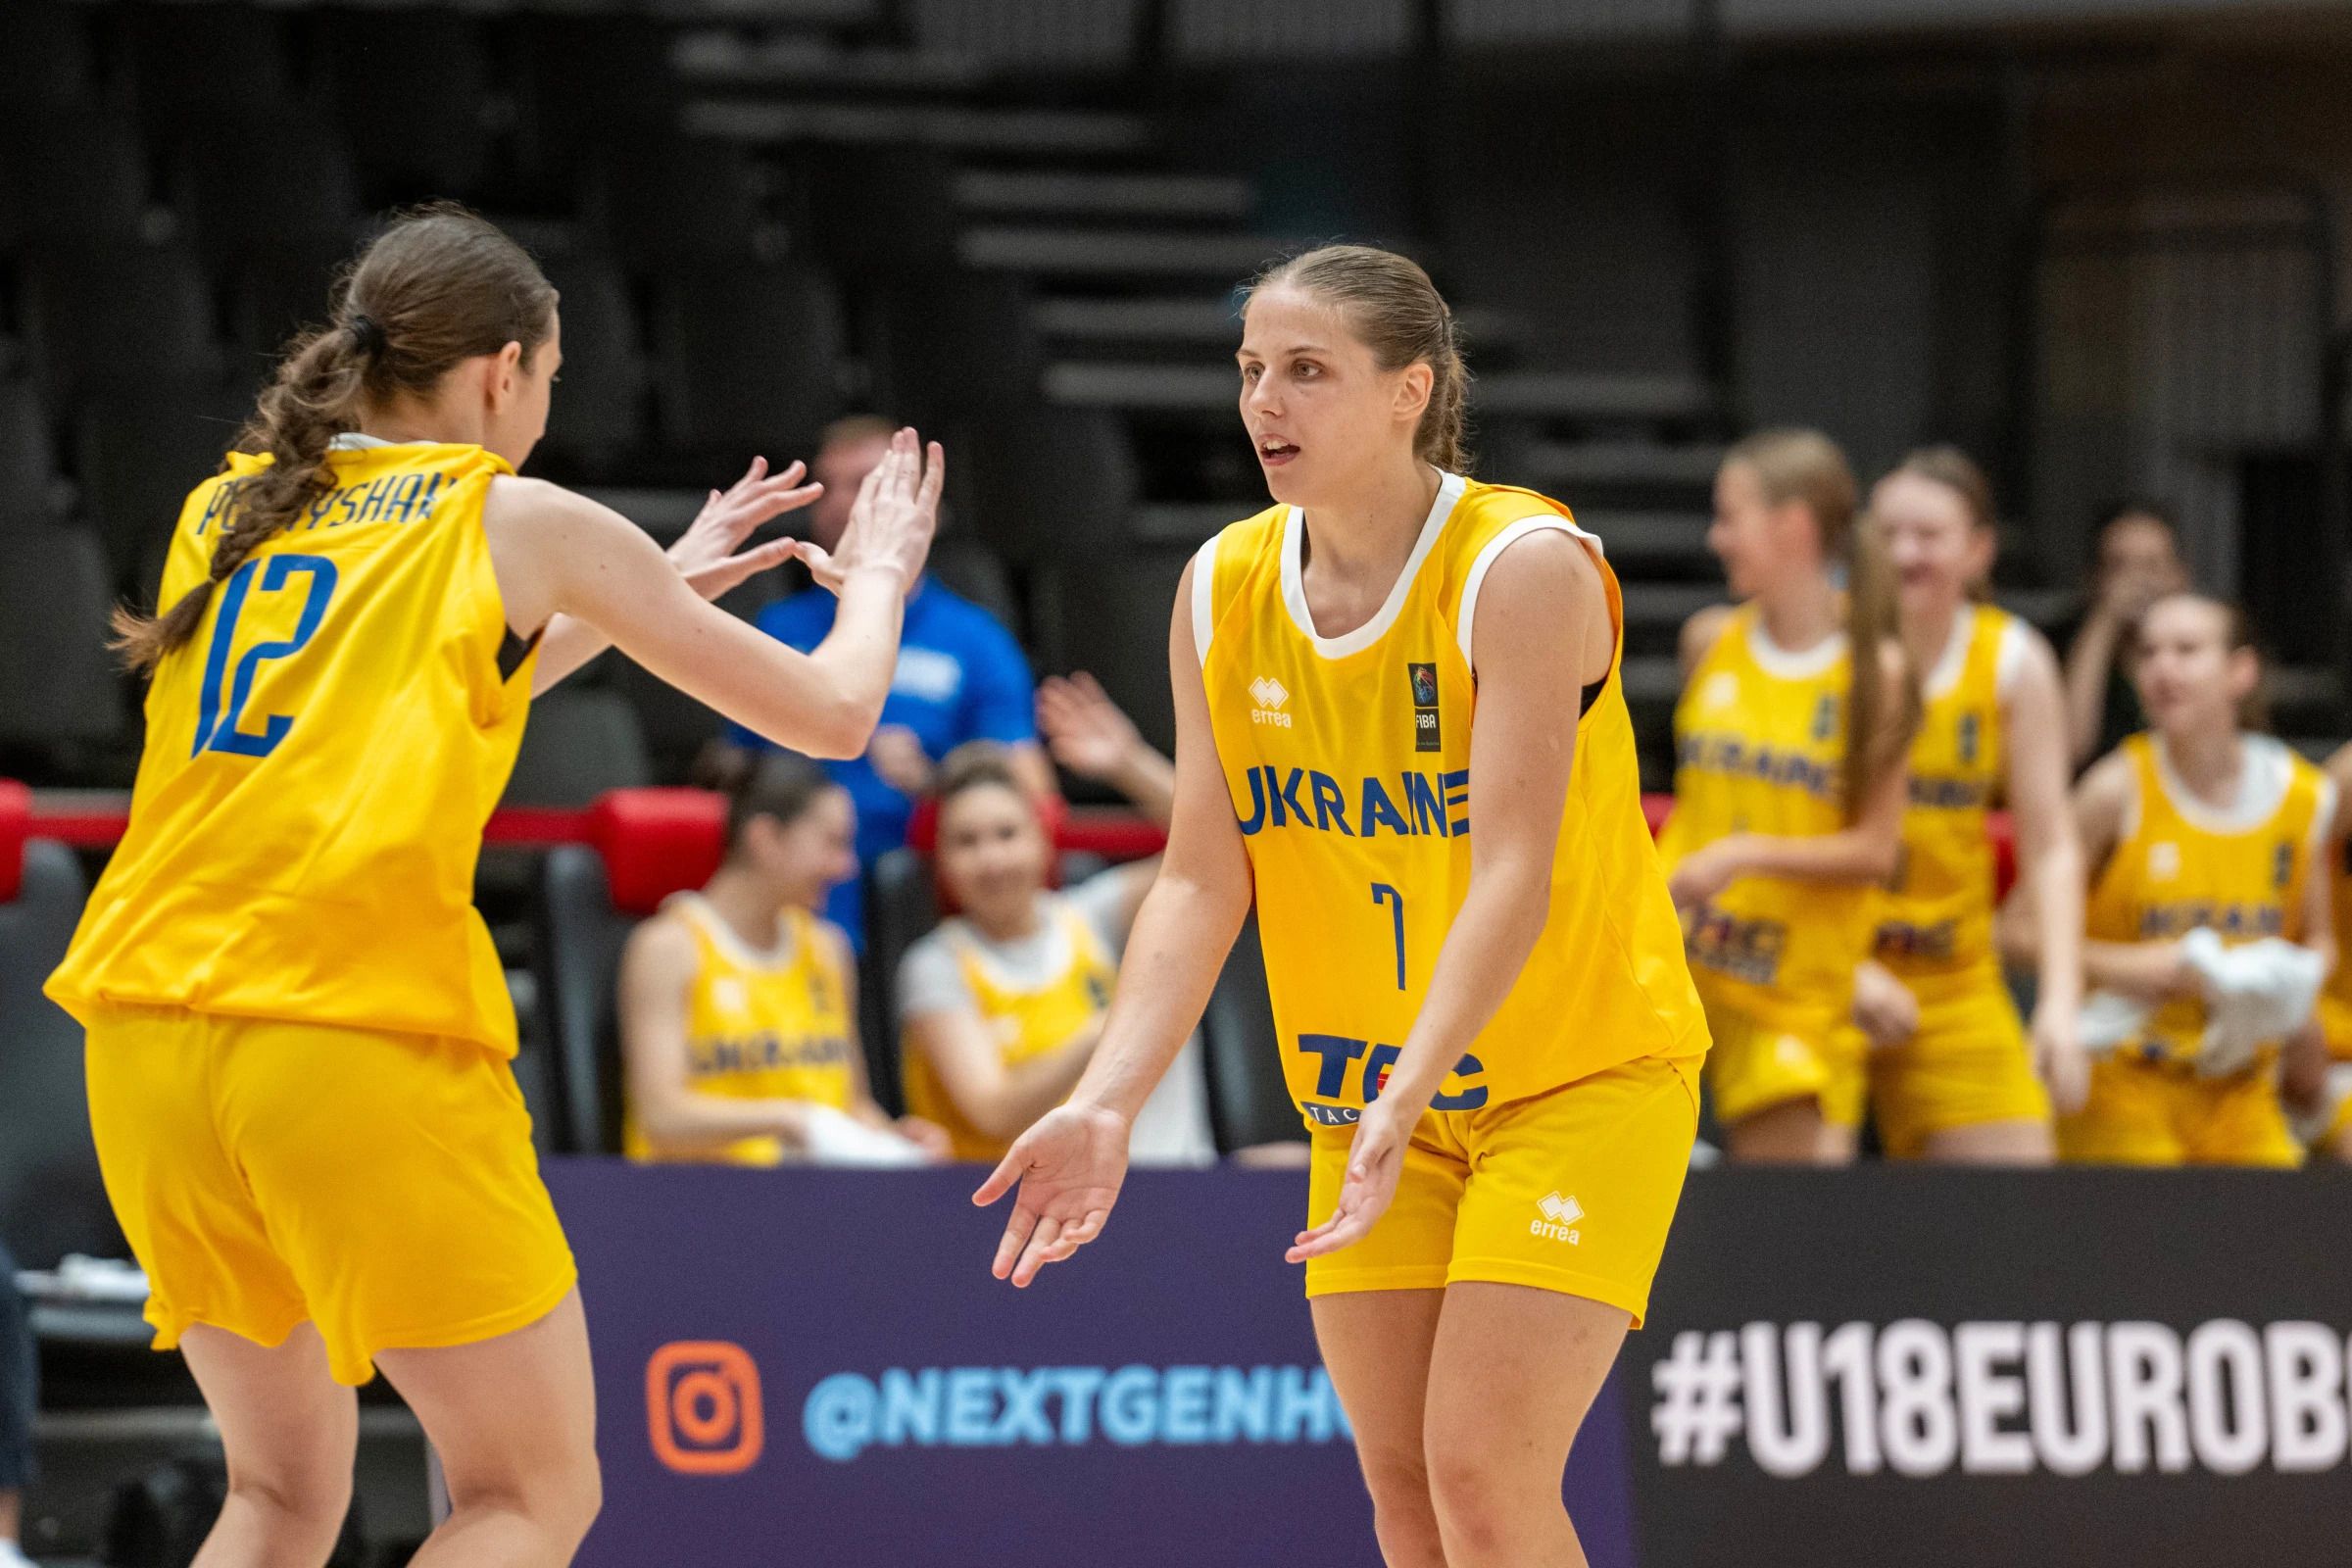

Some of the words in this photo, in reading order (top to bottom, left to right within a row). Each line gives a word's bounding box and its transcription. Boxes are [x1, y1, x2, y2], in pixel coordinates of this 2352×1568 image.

[191, 554, 338, 760] 12
[1250, 708, 1293, 729] errea
[1415, 713, 1437, 729] FIBA
[1238, 764, 1470, 838] UKRAINE
[1370, 882, 1406, 991] 7
[1530, 1219, 1581, 1247] errea
[1650, 1318, 2352, 1476] #U18EUROB
